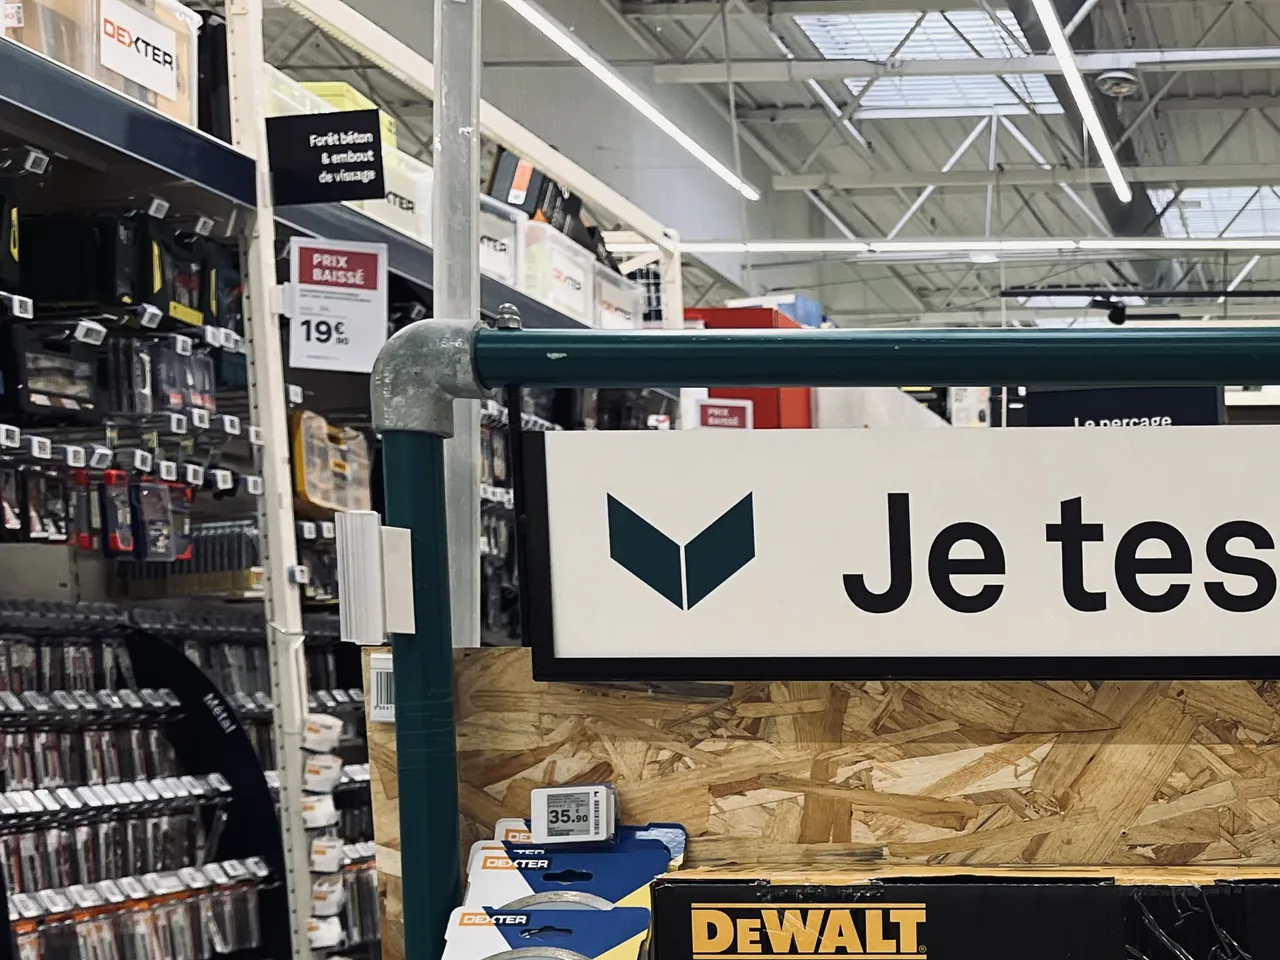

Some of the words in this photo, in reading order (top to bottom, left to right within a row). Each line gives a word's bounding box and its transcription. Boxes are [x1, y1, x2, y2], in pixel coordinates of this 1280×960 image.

[103, 18, 174, 71] DEXTER
[331, 149, 375, 163] embout
[312, 253, 348, 268] PRIX
[312, 268, 365, 285] BAISSÉ
[301, 320, 332, 343] 19
[334, 322, 345, 335] €
[842, 492, 1005, 613] Je
[203, 692, 237, 734] Métal
[485, 858, 549, 868] DEXTER
[462, 915, 527, 925] DEXTER
